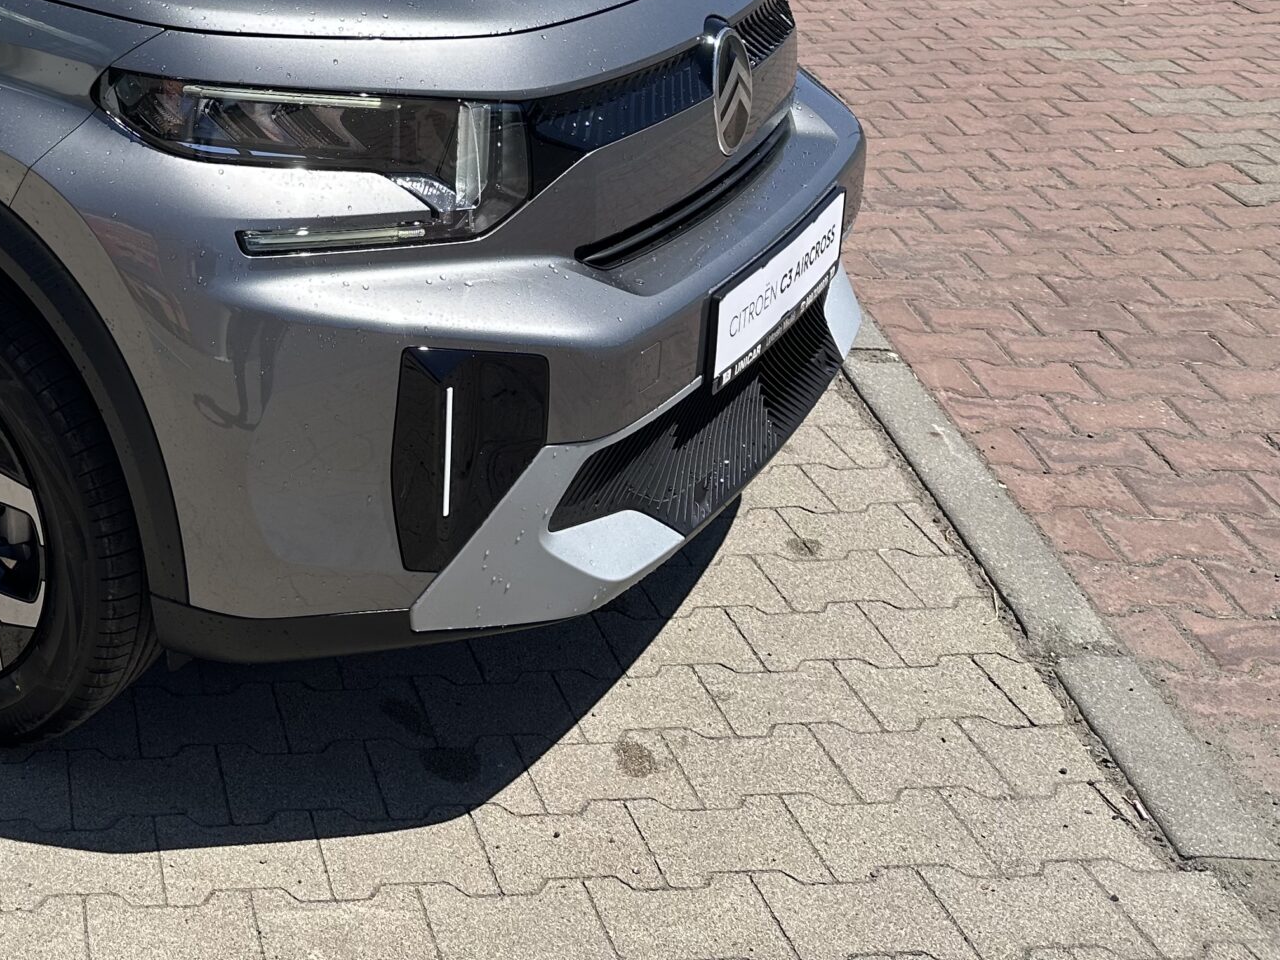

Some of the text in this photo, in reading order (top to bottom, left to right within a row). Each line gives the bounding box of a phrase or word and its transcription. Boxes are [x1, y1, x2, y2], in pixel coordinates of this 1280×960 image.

[729, 281, 778, 337] CITROËN
[780, 267, 793, 294] C3
[793, 224, 836, 282] AIRCROSS
[734, 344, 762, 375] UNICAR
